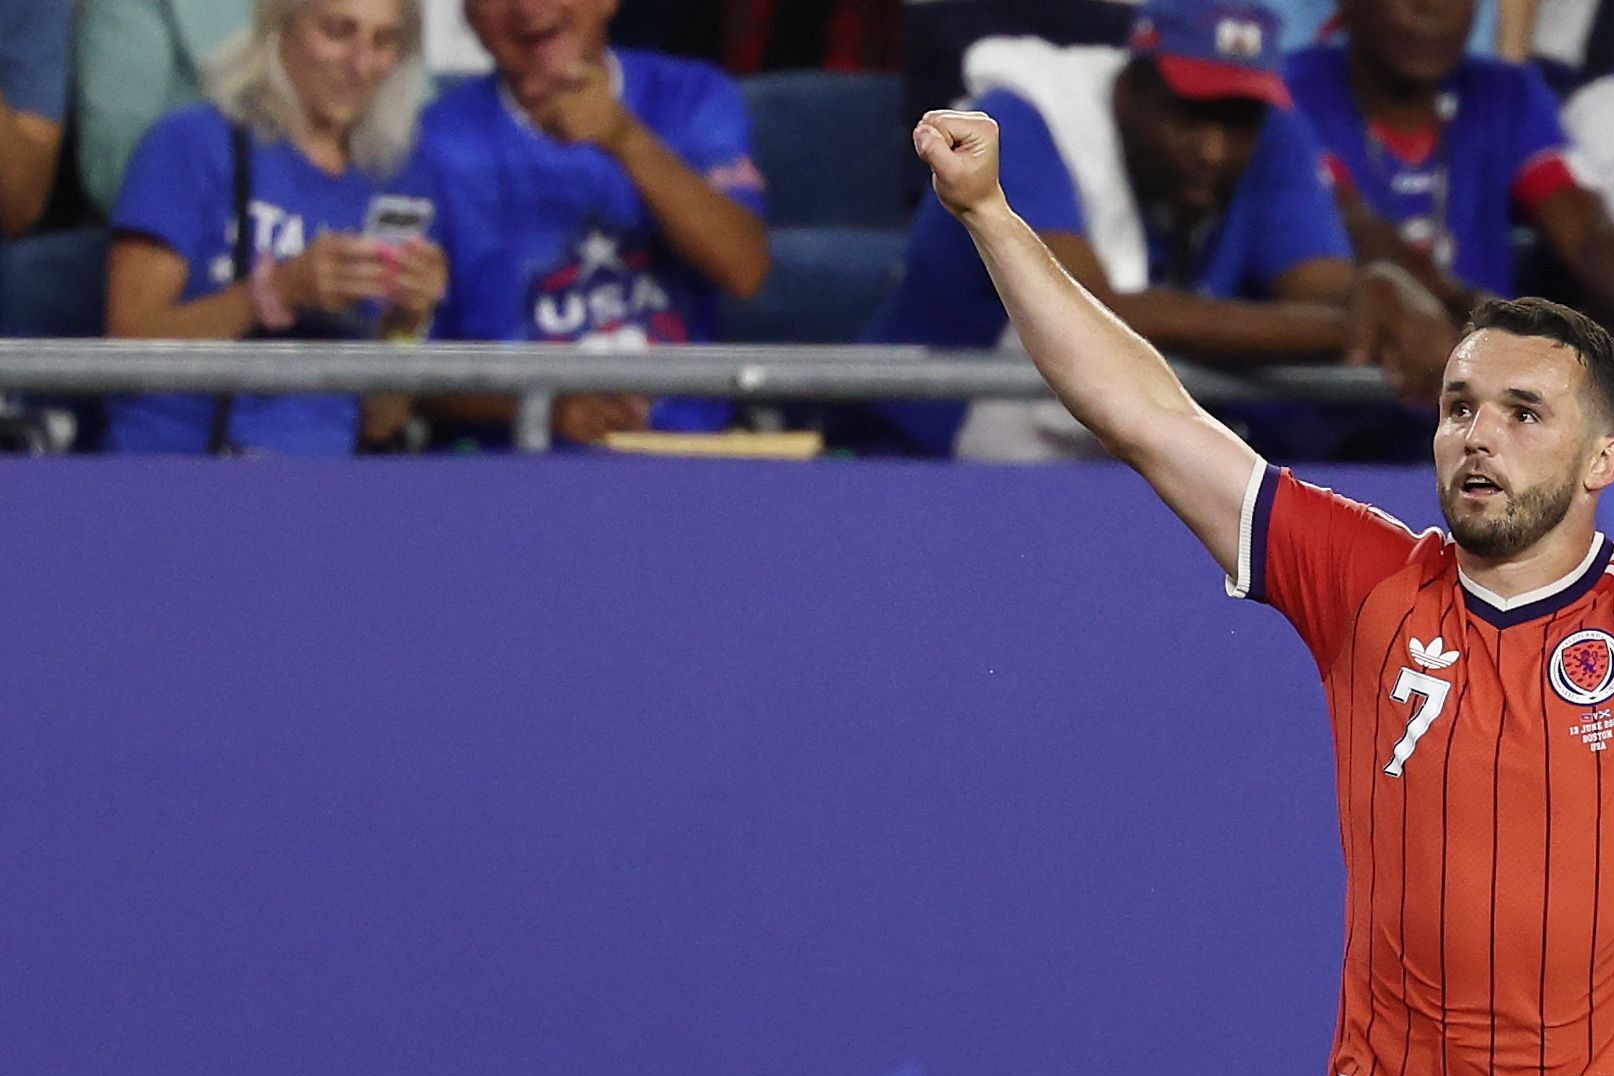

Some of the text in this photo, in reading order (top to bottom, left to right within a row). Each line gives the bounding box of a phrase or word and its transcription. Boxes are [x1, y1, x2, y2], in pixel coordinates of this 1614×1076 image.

[534, 273, 670, 335] USA
[1382, 666, 1451, 777] 7
[1581, 722, 1603, 733] JUNE
[1583, 730, 1612, 743] BOSTON
[1590, 741, 1606, 751] USA
